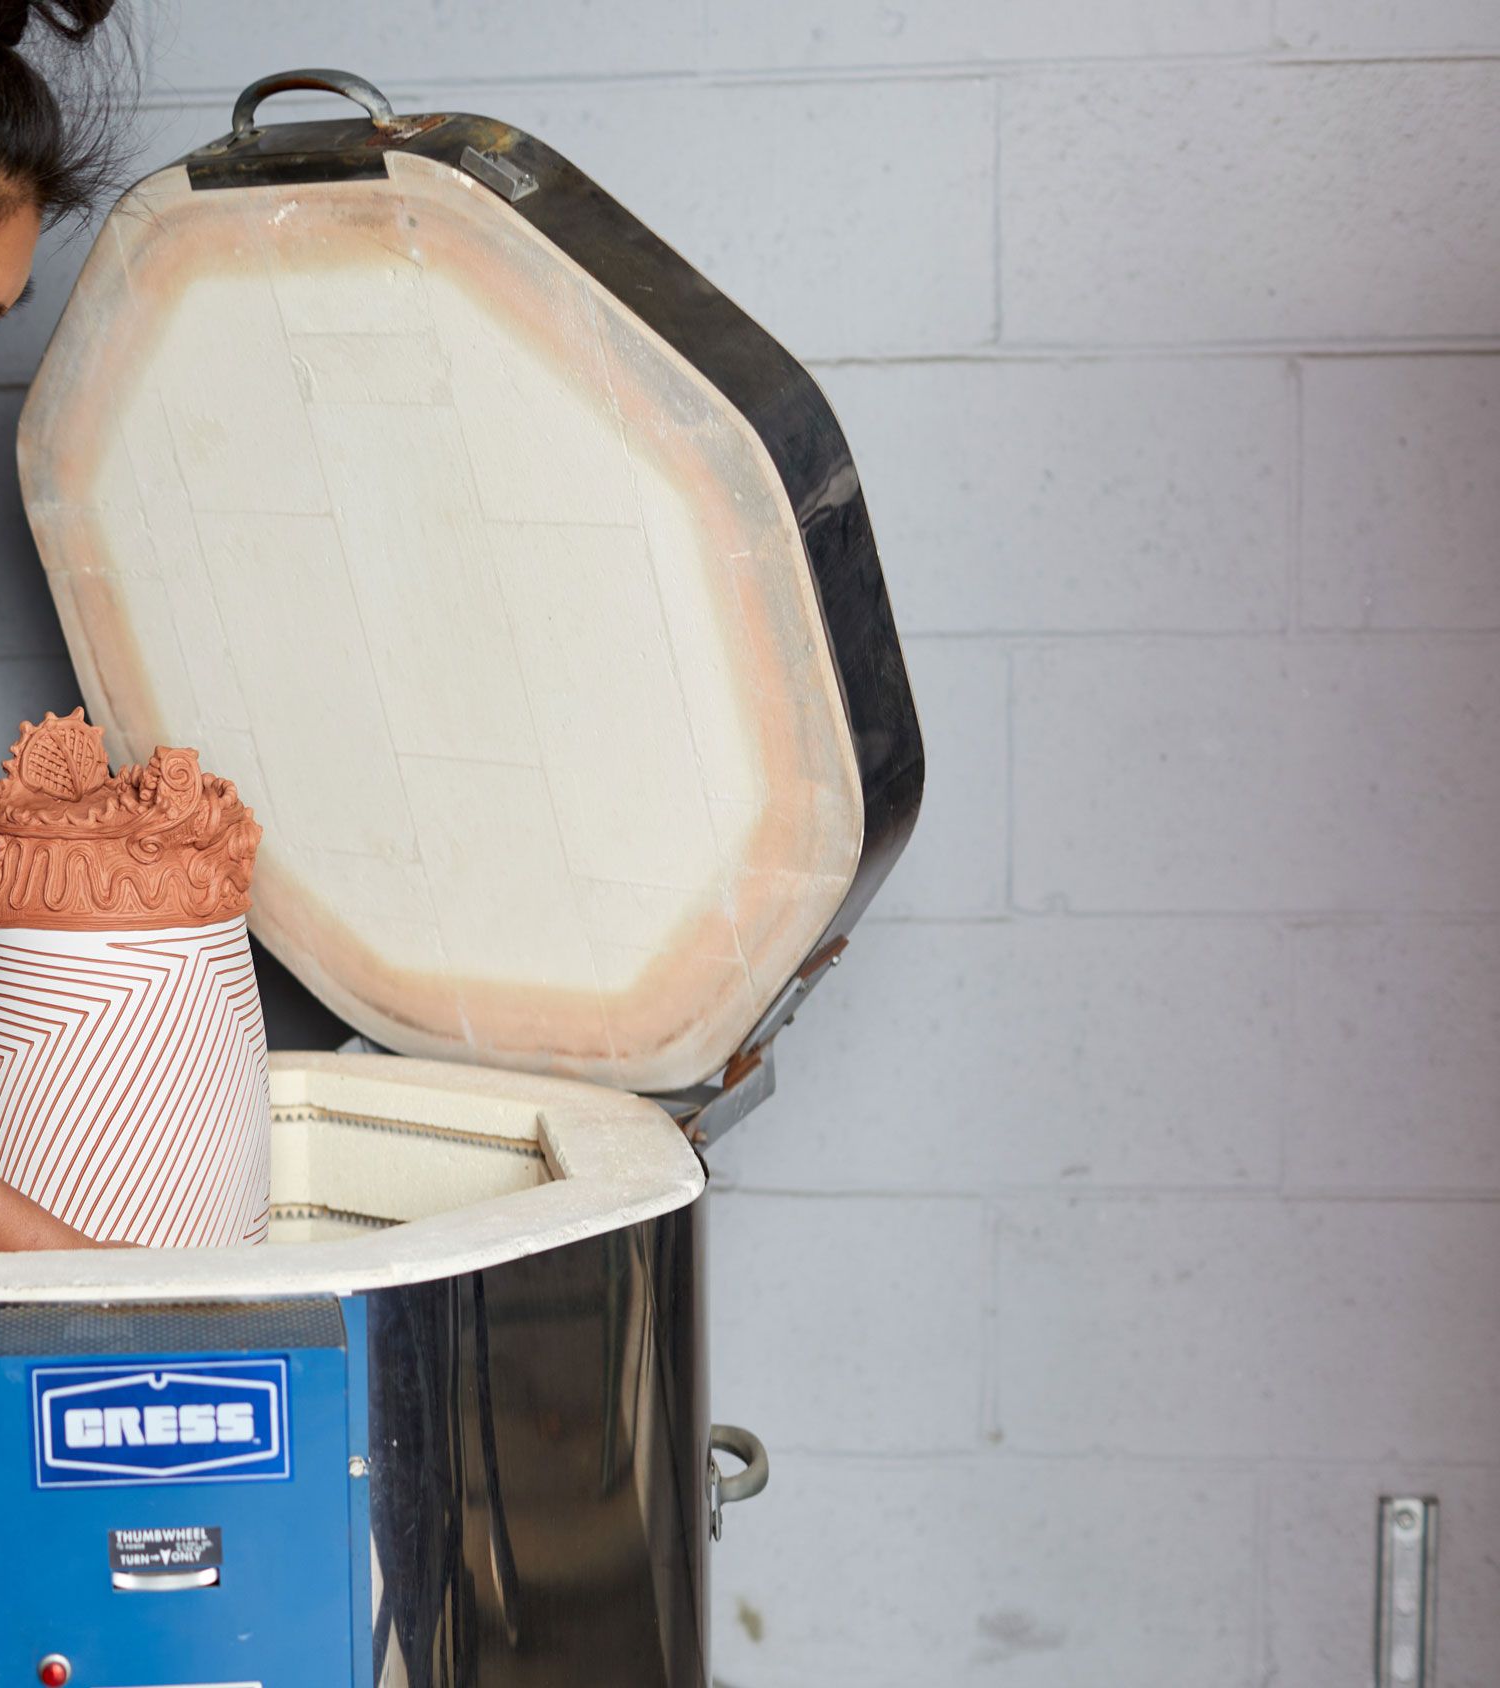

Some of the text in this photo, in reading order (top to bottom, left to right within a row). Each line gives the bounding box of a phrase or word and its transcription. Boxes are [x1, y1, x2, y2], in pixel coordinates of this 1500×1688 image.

[64, 1402, 255, 1449] CRESS
[115, 1527, 208, 1543] THUMBWHEEL
[120, 1551, 202, 1566] TURN ONLY
